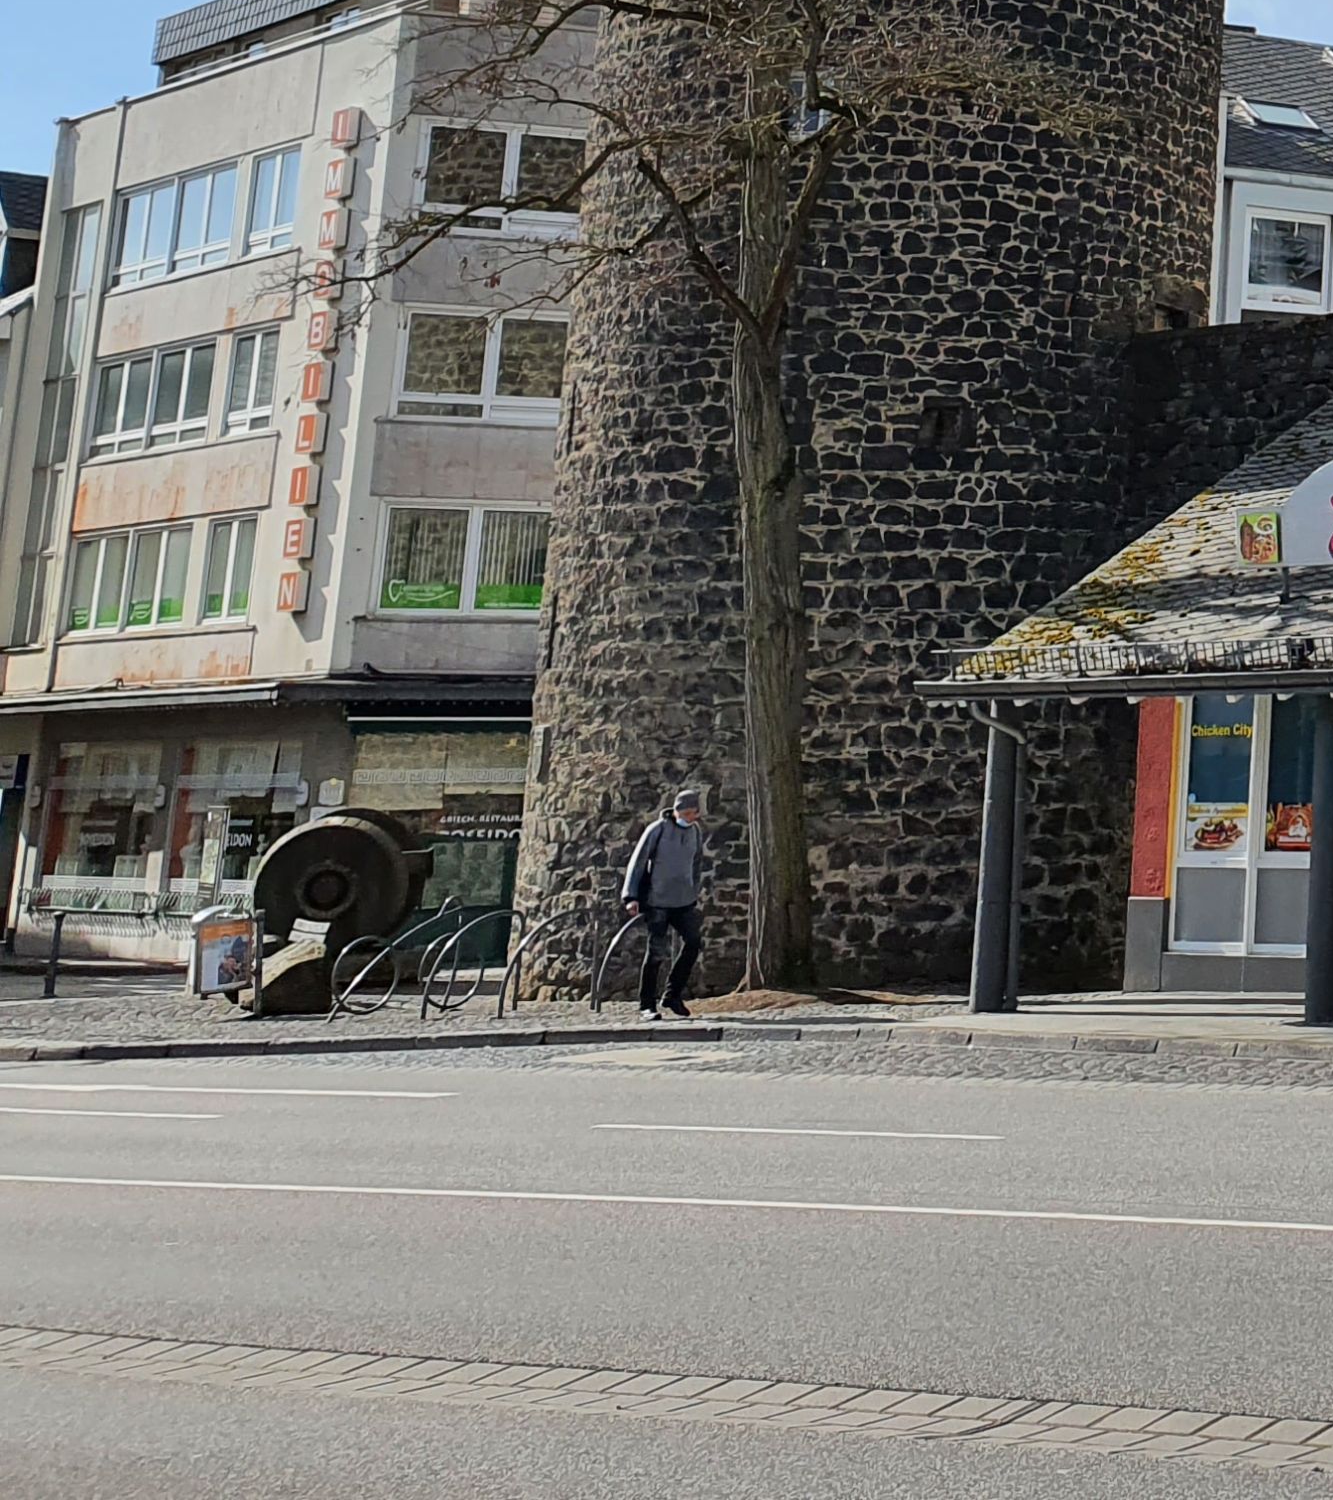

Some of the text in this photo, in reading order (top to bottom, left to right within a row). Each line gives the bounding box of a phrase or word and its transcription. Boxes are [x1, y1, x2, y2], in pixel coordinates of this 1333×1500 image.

[279, 112, 346, 602] IMMOBILIEN
[1192, 723, 1253, 738] Chicken City
